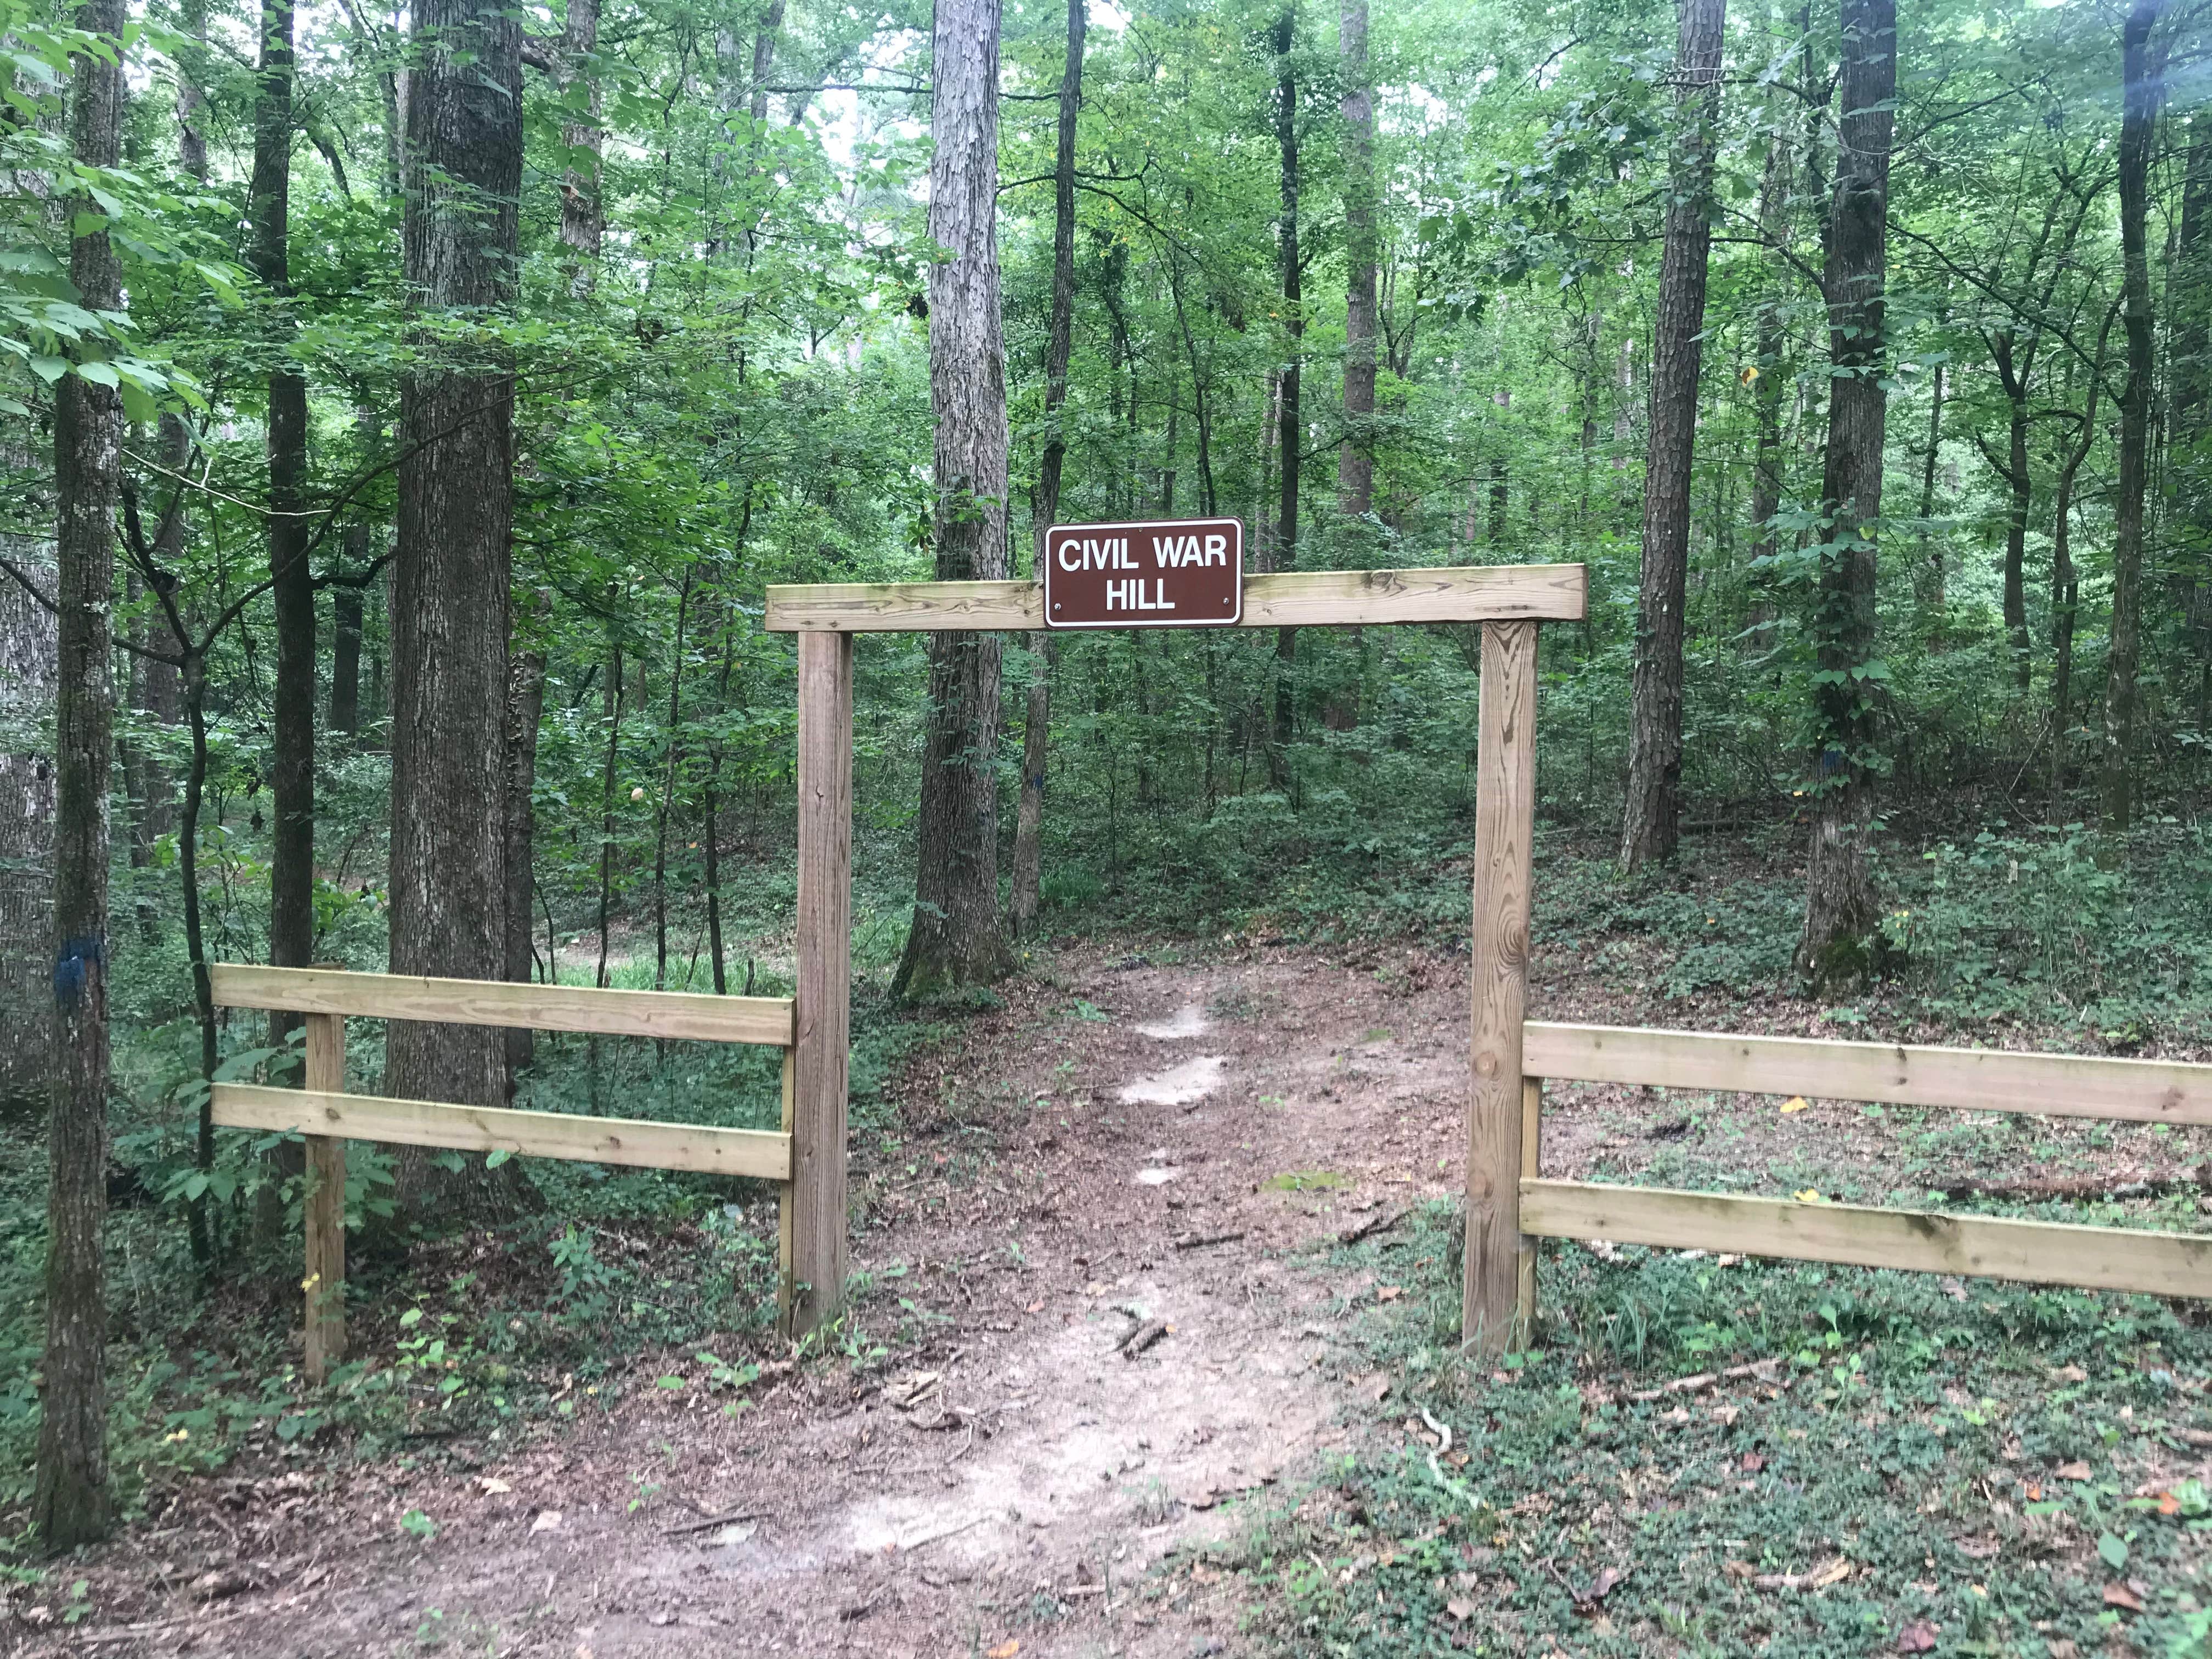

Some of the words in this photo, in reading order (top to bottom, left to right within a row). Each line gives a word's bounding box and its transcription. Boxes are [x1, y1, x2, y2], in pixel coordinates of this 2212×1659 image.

[1058, 538, 1139, 572] CIVIL
[1152, 534, 1227, 568] WAR
[1106, 578, 1176, 611] HILL
